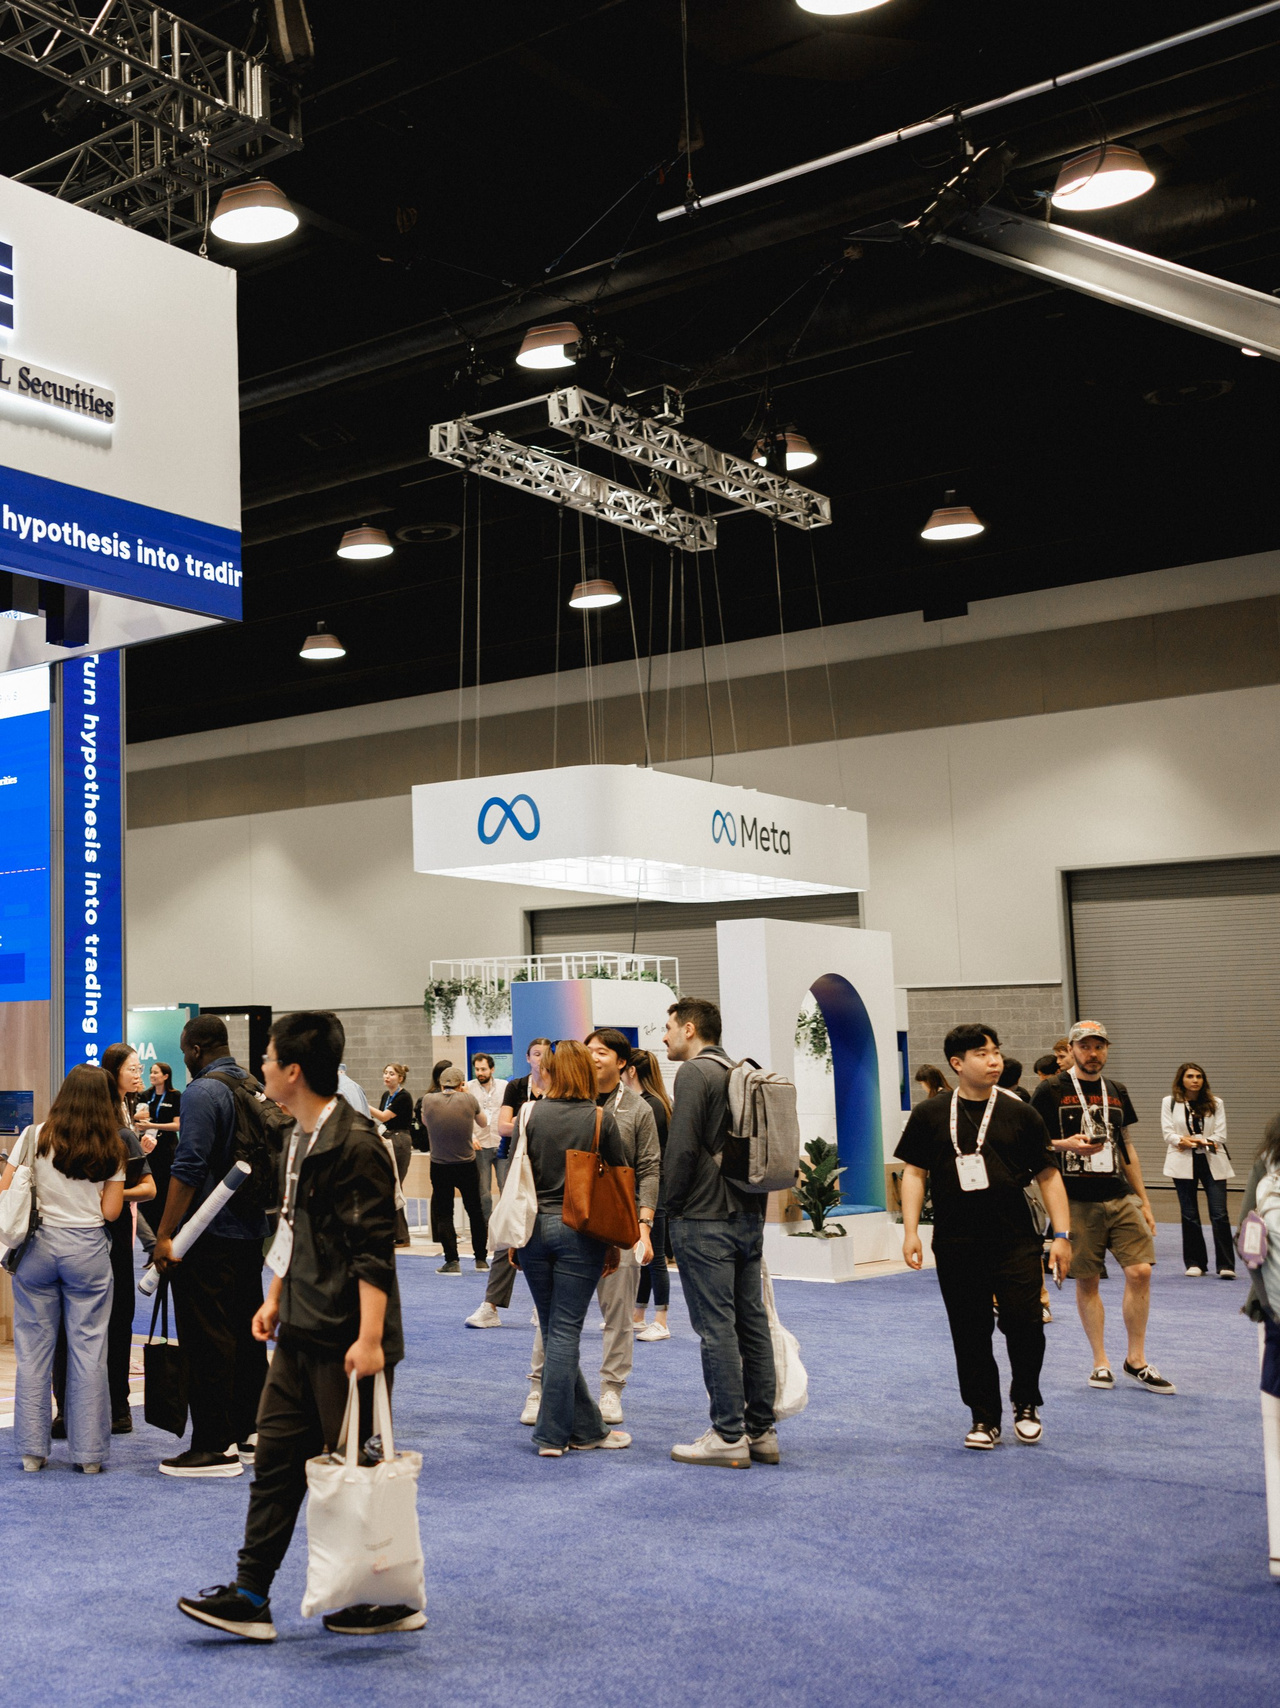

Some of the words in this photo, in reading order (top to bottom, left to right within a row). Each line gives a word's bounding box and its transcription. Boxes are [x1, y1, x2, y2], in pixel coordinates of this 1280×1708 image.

[18, 366, 115, 418] Securities
[2, 503, 131, 560] hypothesis
[137, 538, 180, 572] into
[80, 713, 100, 863] hypothesis
[740, 814, 791, 856] Meta
[84, 871, 101, 926] into
[81, 933, 101, 1034] trading
